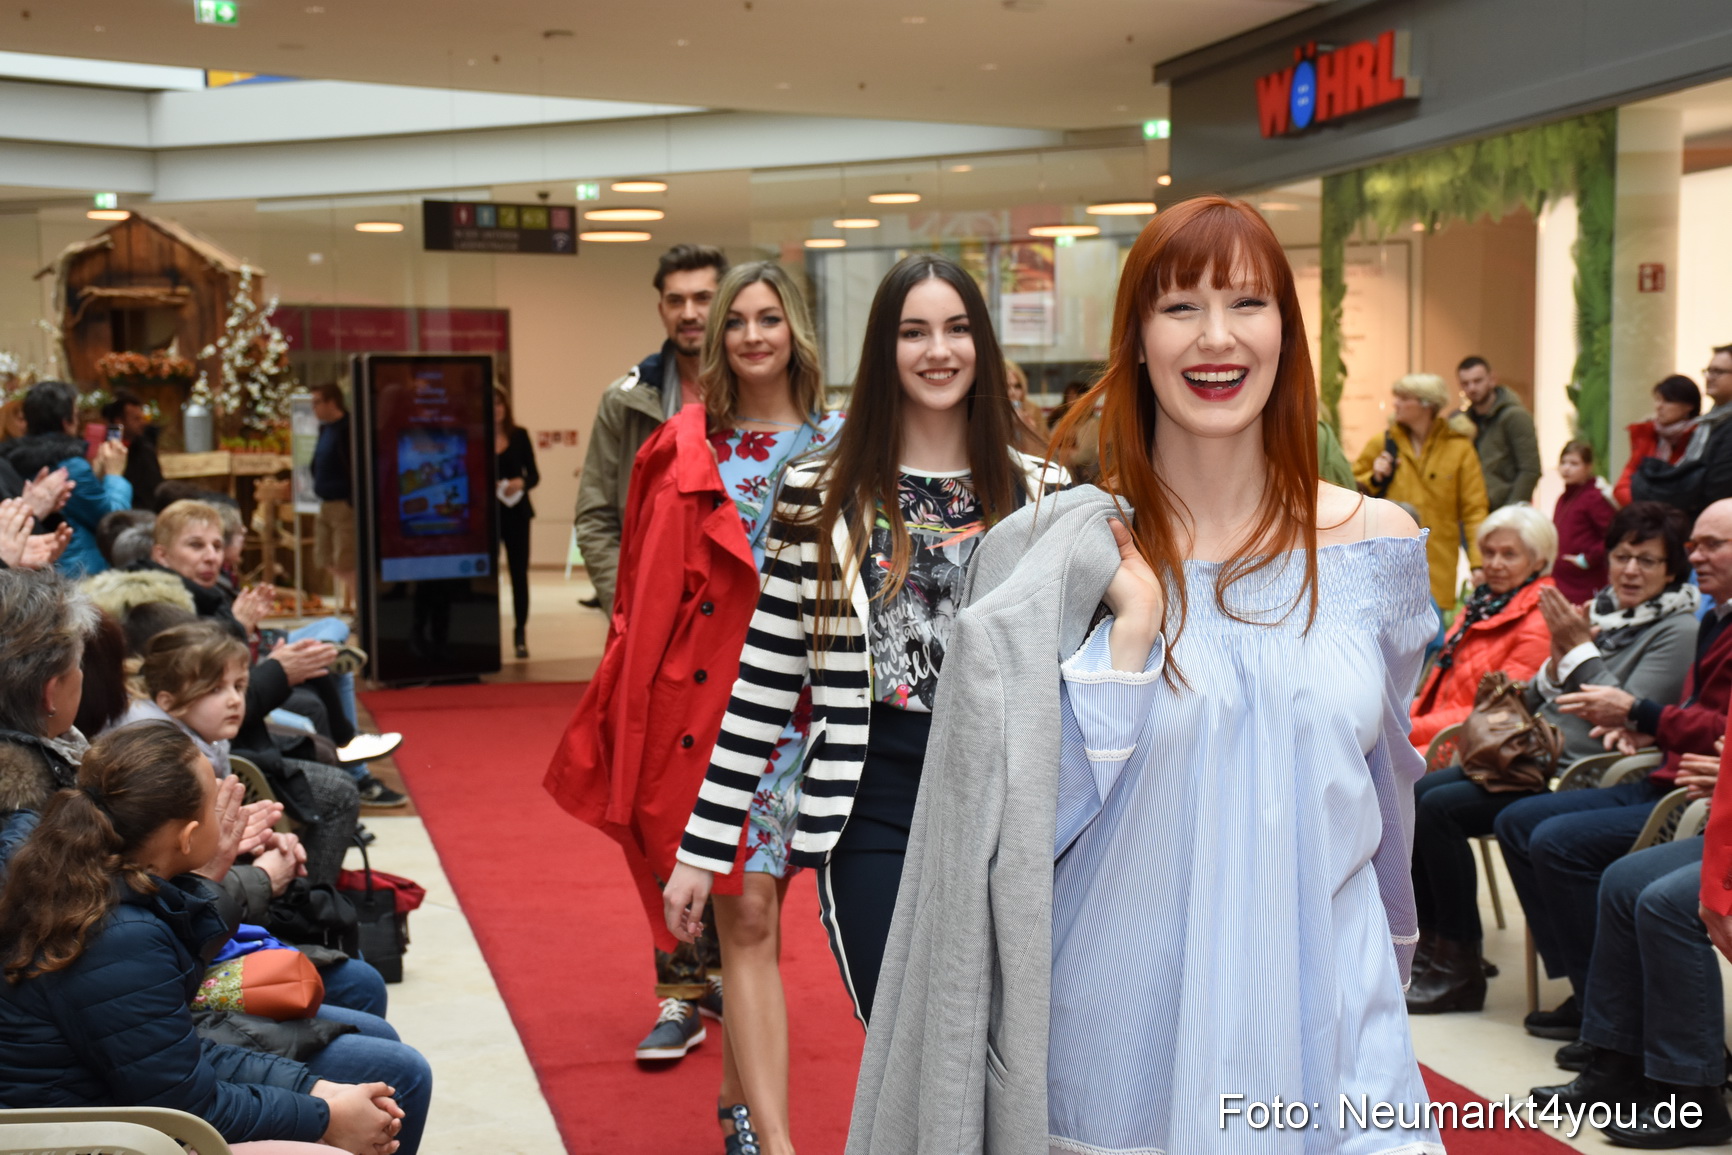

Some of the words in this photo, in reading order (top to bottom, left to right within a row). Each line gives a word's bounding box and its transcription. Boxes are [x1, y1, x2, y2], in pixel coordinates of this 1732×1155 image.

[1257, 30, 1404, 138] WÖHRL
[878, 603, 917, 640] your
[874, 653, 912, 680] run
[887, 643, 939, 689] wild
